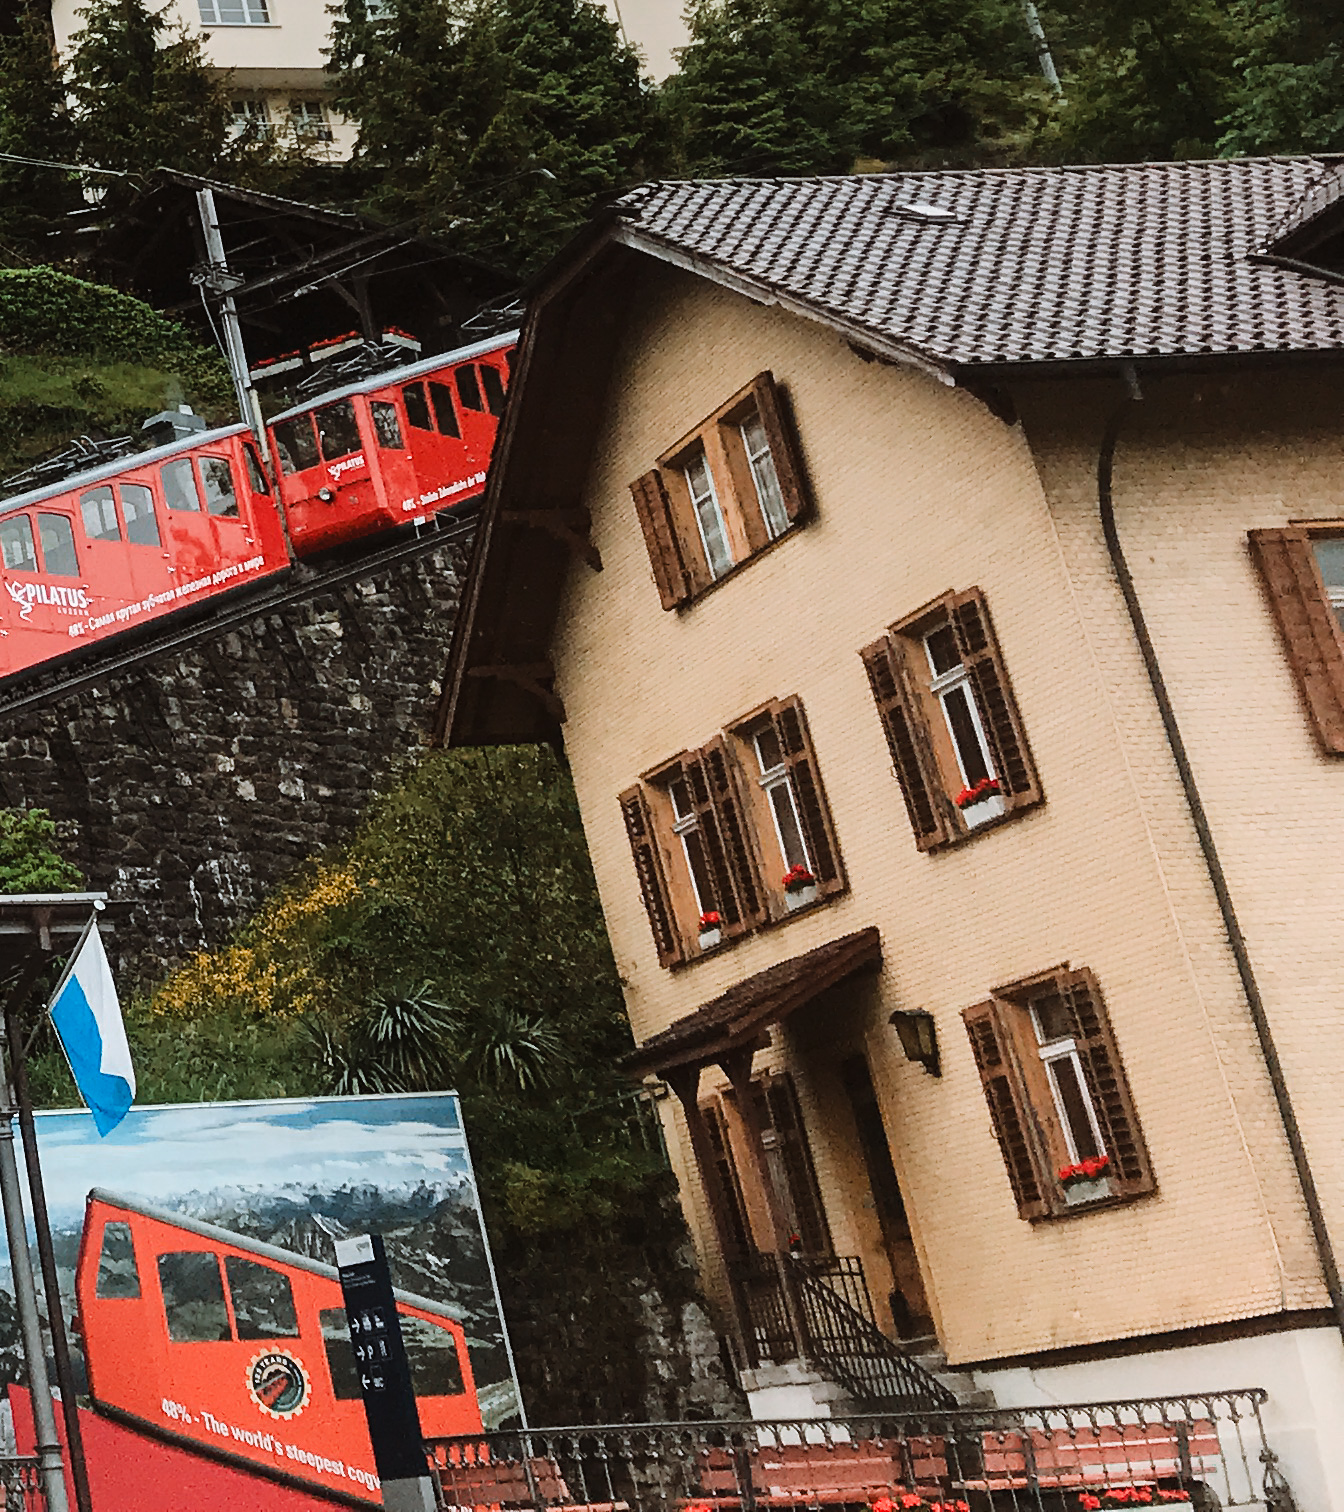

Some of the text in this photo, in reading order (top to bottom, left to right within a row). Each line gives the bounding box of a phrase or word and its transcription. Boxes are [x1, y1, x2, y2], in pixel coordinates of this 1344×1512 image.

[25, 583, 89, 609] PILATUS
[161, 1398, 192, 1424] 48%
[200, 1411, 230, 1437] The
[230, 1425, 284, 1456] world's
[285, 1444, 346, 1477] steepest
